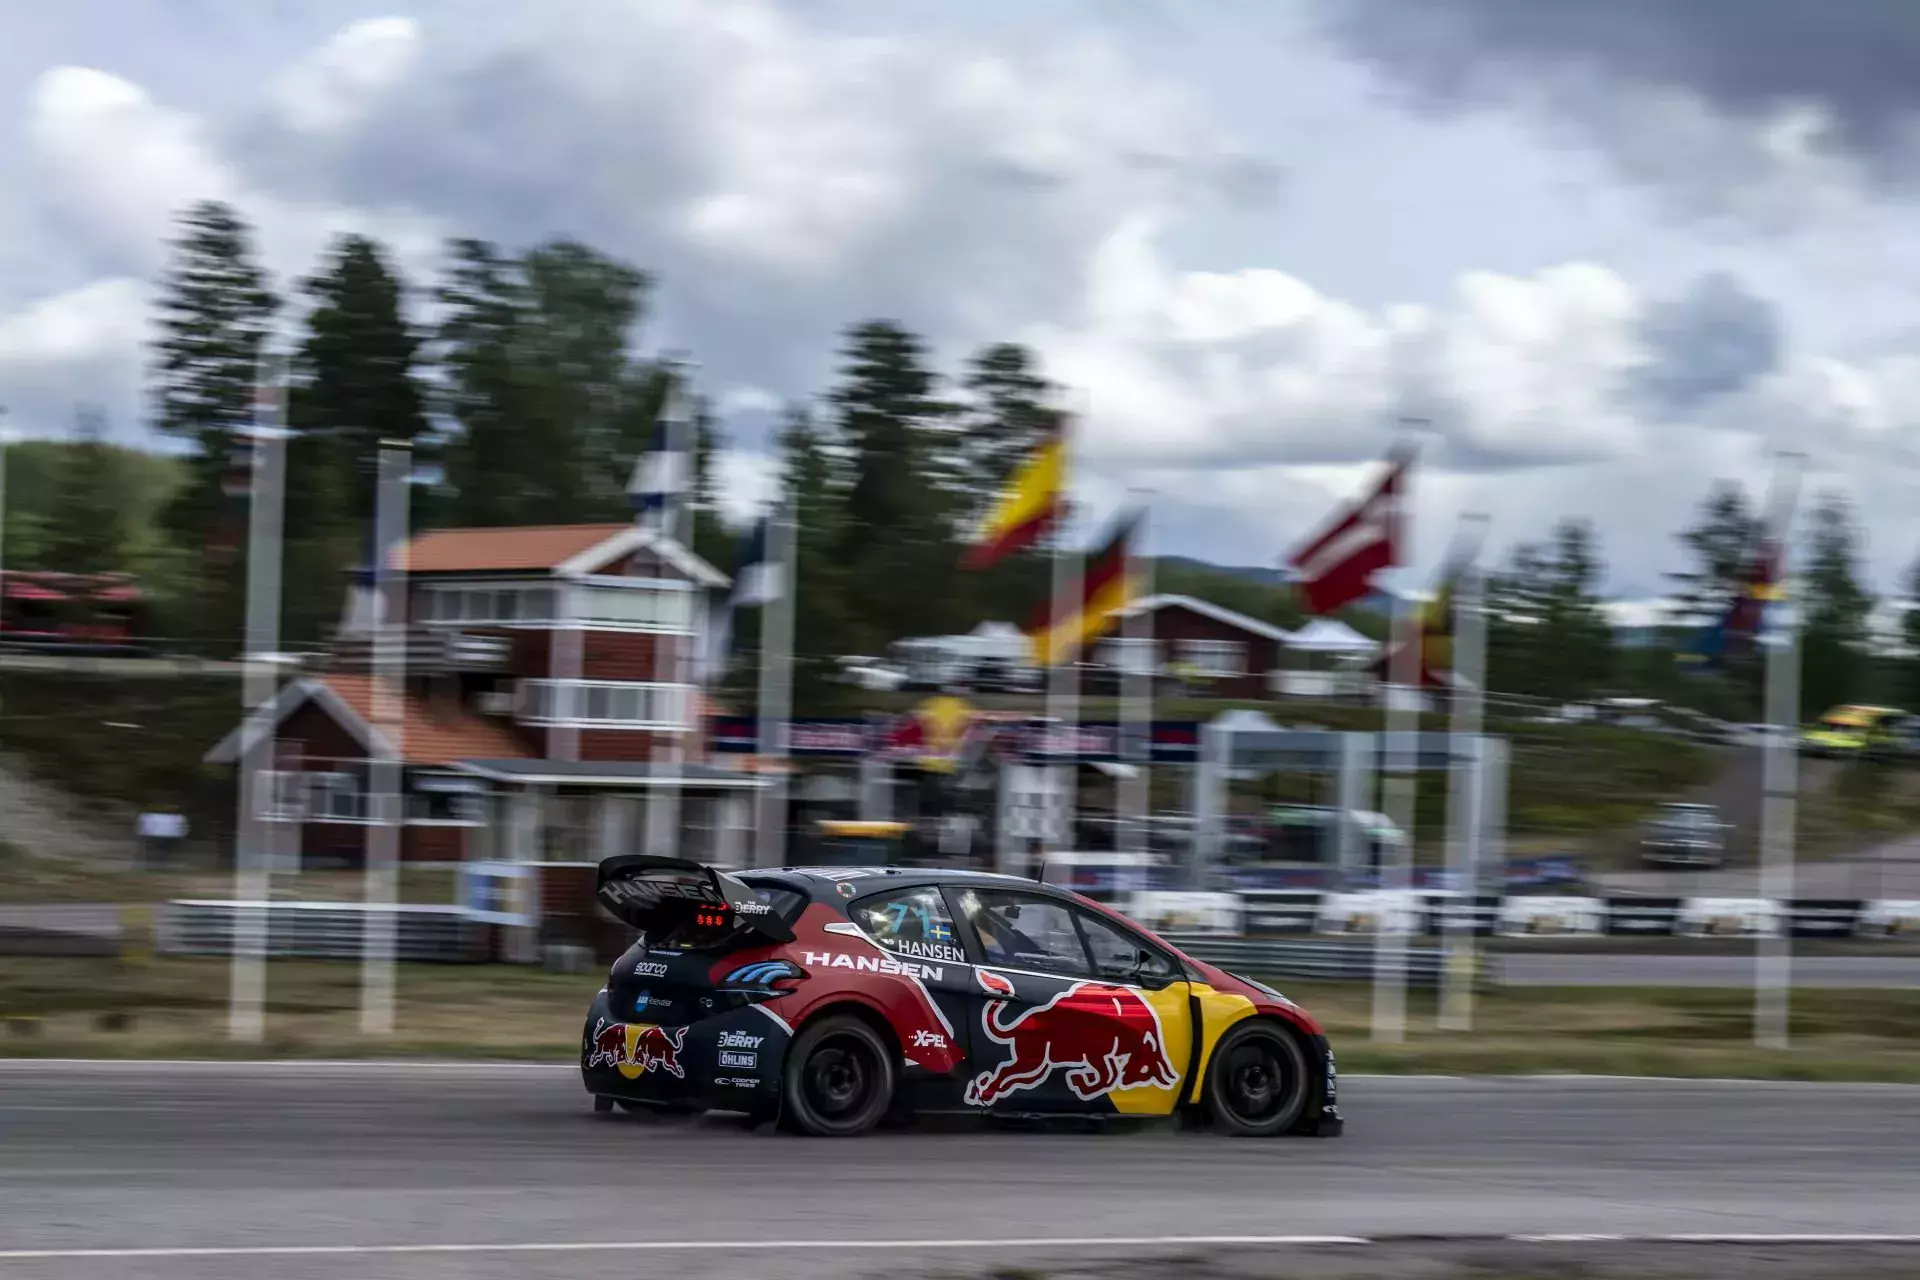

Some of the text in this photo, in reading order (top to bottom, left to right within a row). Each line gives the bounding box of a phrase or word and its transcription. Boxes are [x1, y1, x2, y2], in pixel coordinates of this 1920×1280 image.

[598, 880, 723, 904] HANSEN
[734, 901, 771, 915] BERRY
[887, 902, 930, 940] 71
[898, 939, 965, 962] HANSEN
[635, 961, 668, 975] sparco
[800, 951, 944, 982] HANSEN
[717, 1031, 765, 1048] BERRY
[913, 1029, 948, 1048] XPEL
[721, 1051, 755, 1066] ÖHLINS
